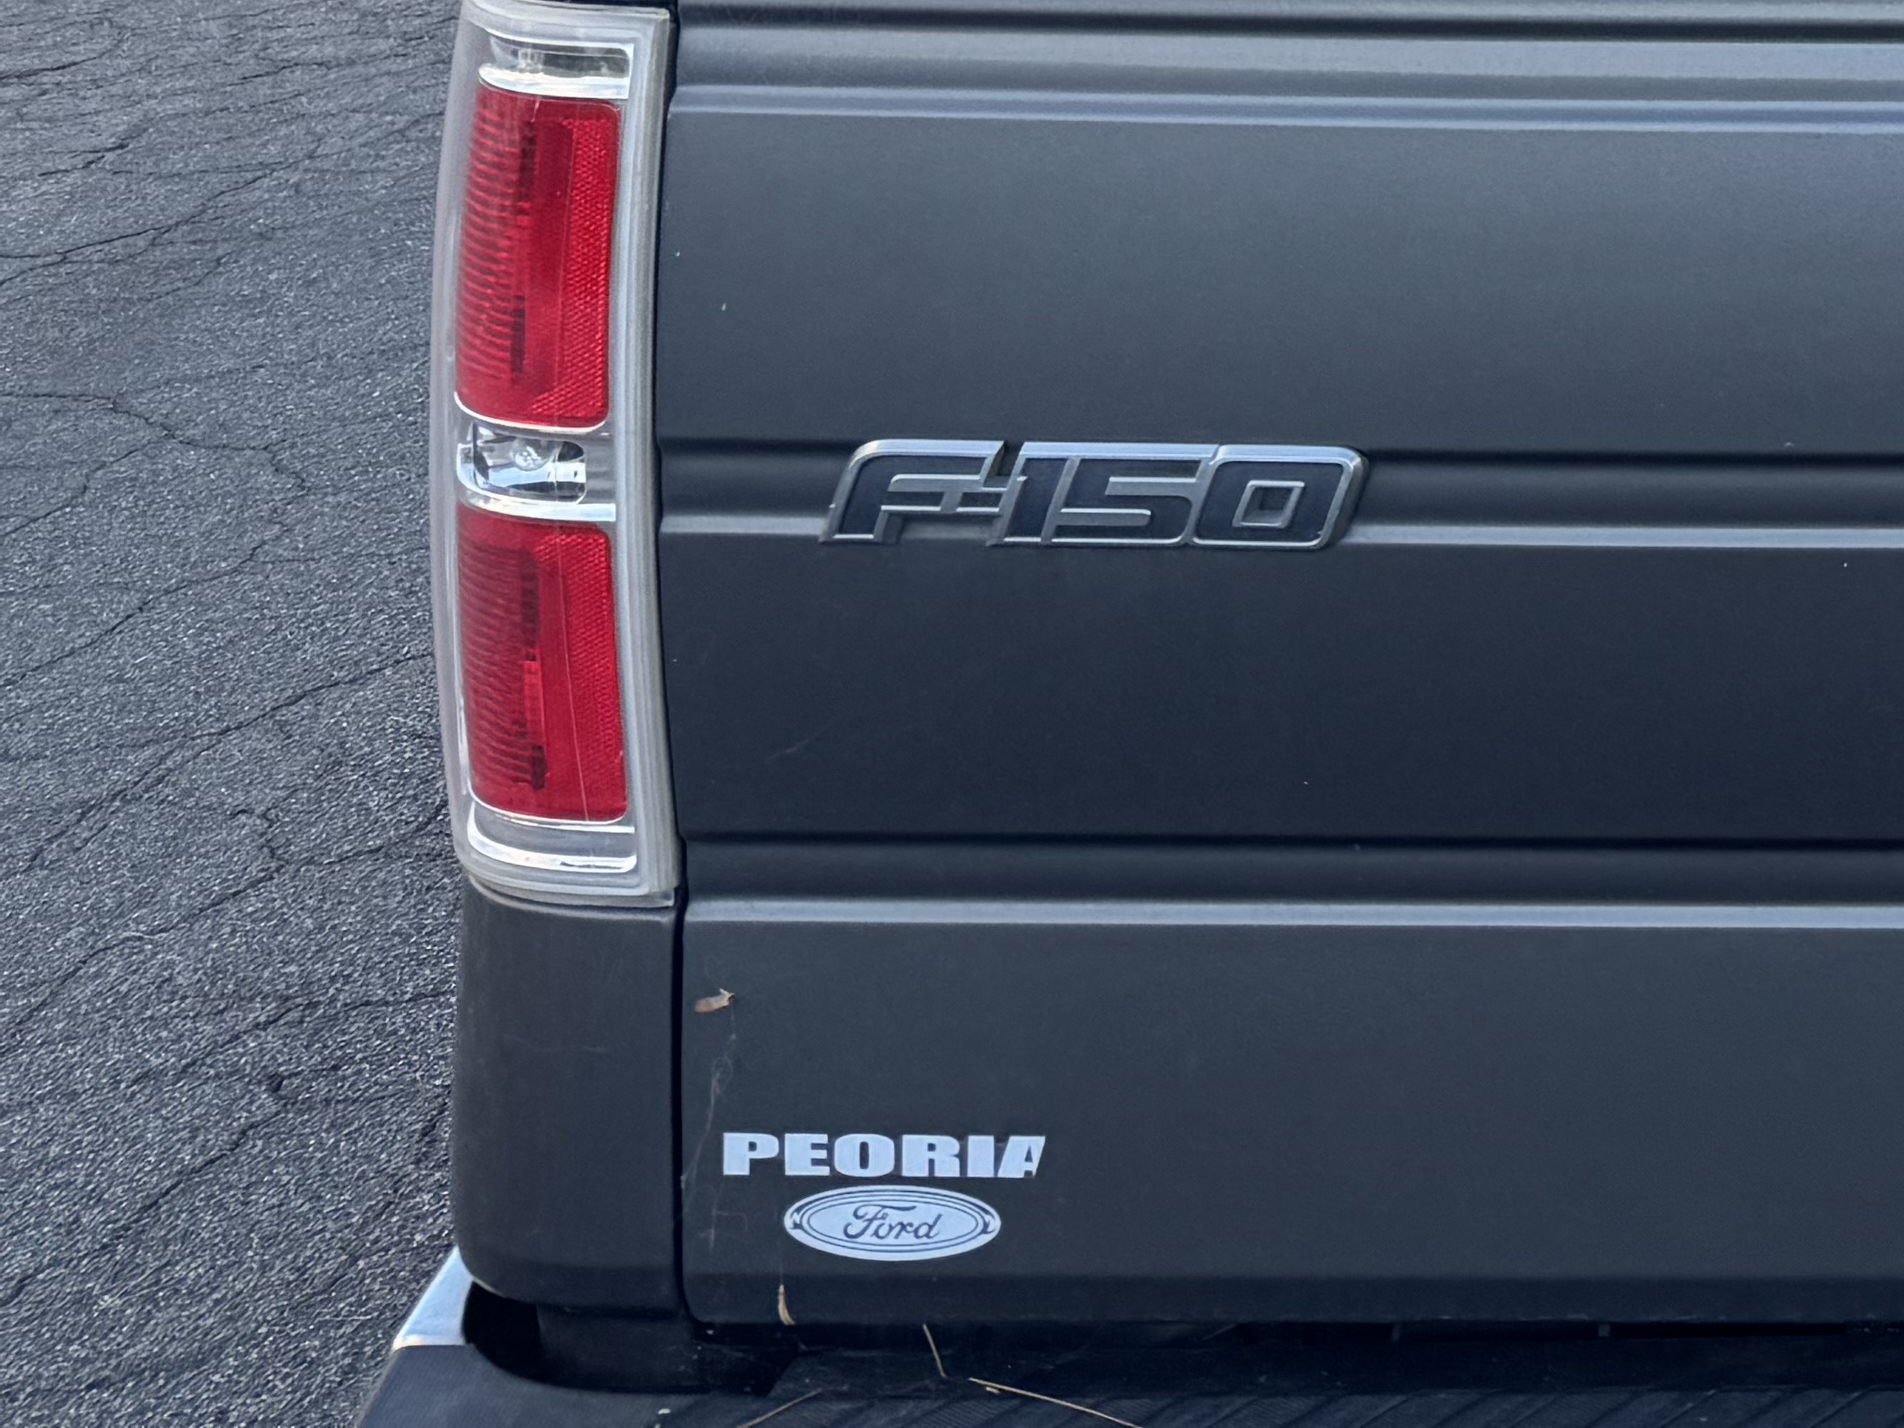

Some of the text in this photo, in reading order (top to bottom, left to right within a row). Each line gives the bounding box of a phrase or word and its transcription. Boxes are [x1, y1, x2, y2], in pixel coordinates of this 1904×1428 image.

[819, 438, 1368, 549] F-150
[723, 1132, 1046, 1178] PEORIA
[843, 1204, 943, 1241] Ford
